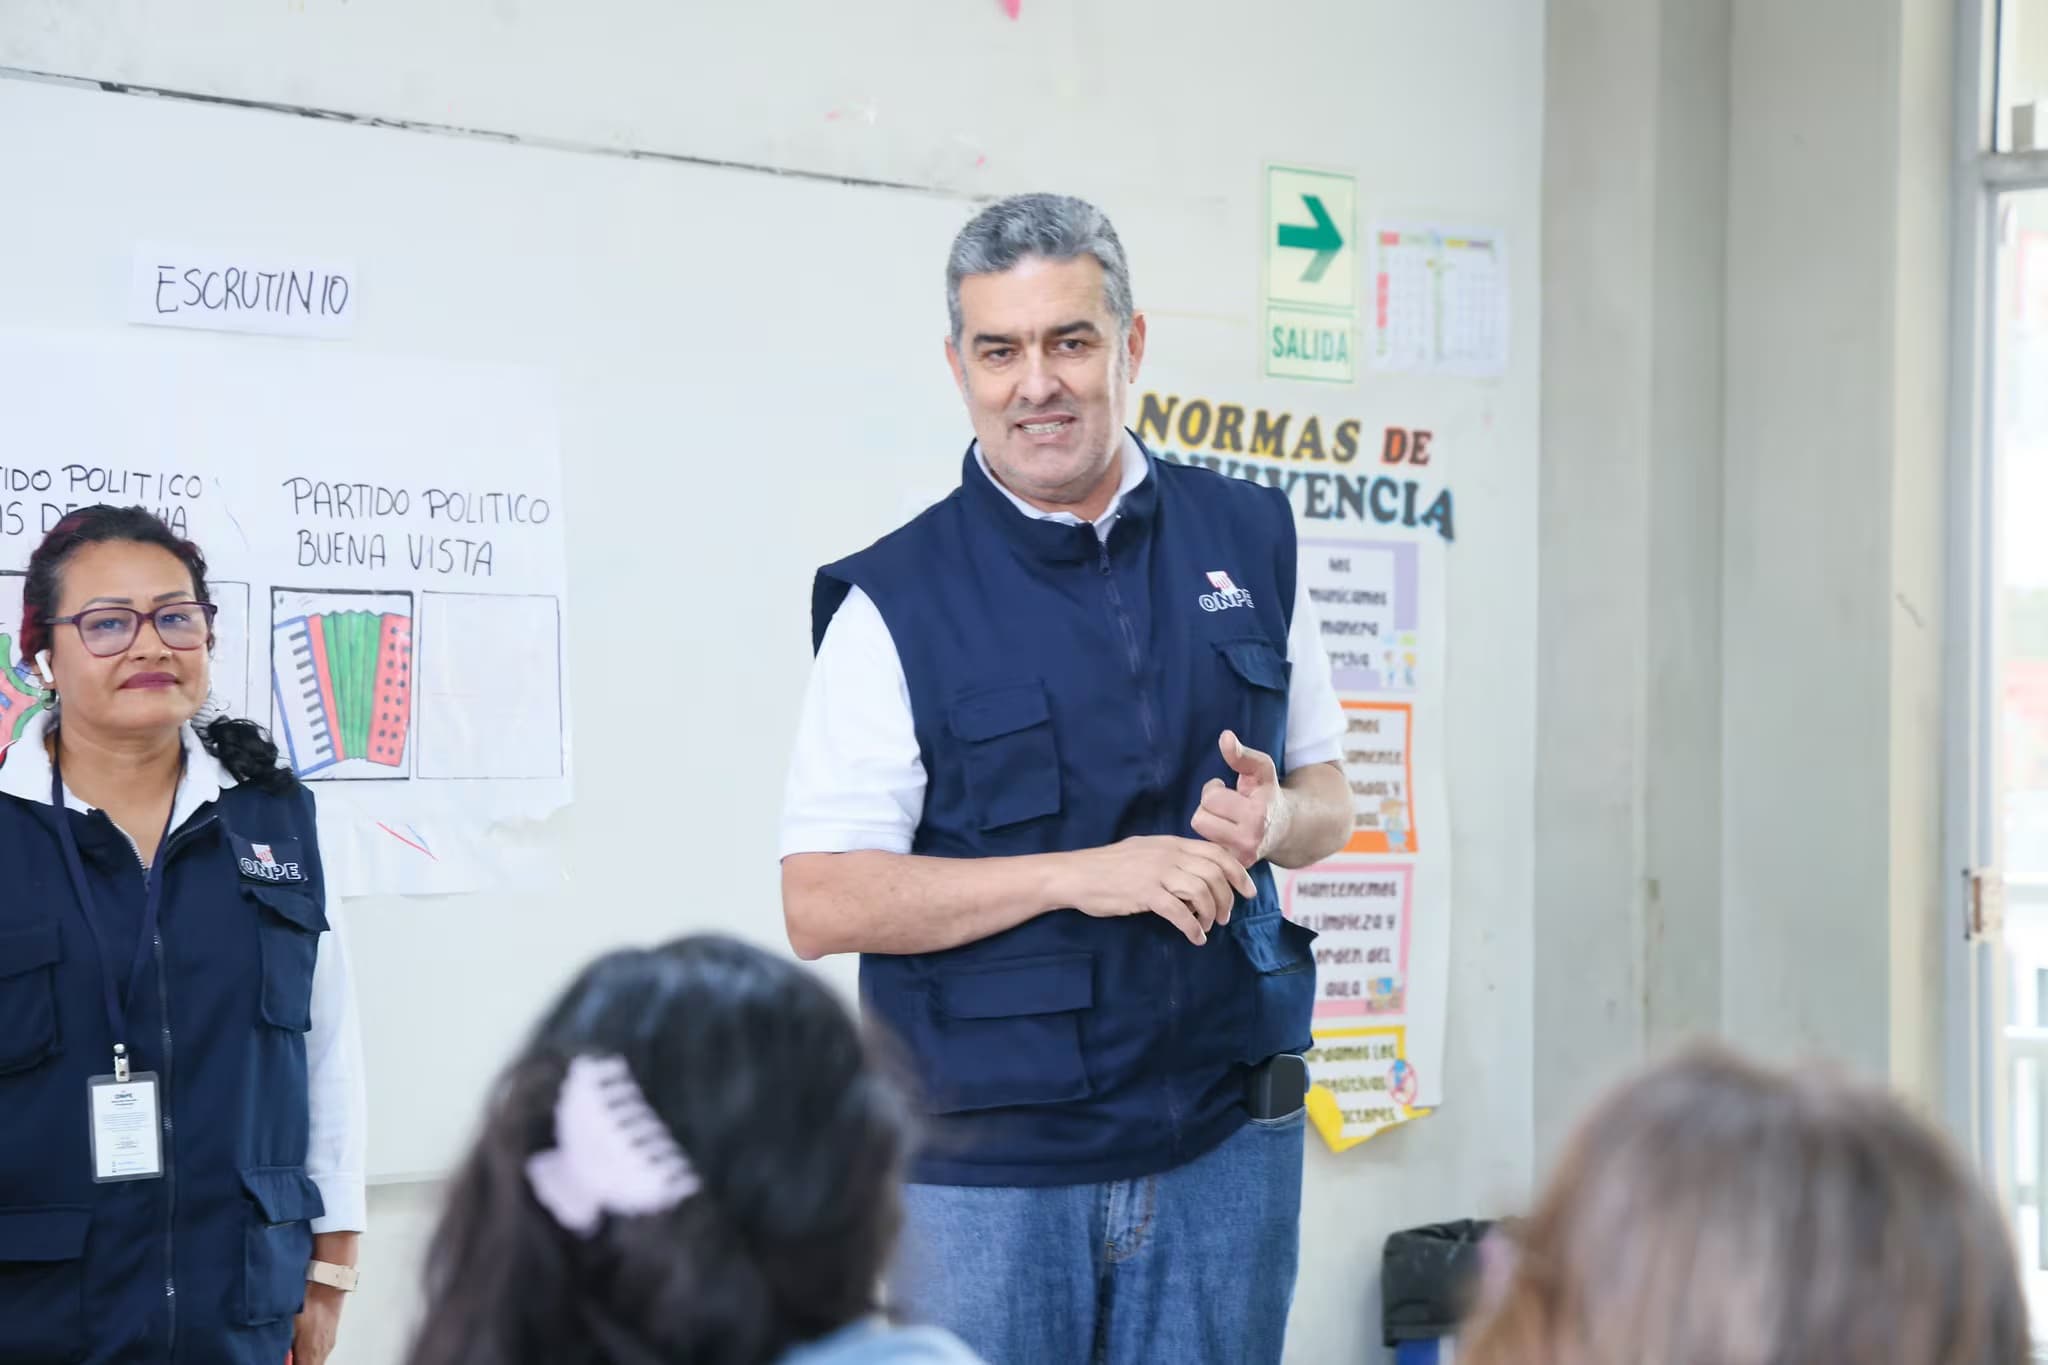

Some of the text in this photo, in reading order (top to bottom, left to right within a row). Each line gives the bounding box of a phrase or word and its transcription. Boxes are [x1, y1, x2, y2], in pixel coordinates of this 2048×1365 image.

[156, 265, 349, 315] ESCRUTINIO
[1272, 325, 1349, 365] SALIDA
[1136, 392, 1433, 466] NORMAS DE
[61, 464, 202, 501] POLITICO
[282, 476, 550, 525] PARTIDO POLITICO
[297, 529, 494, 577] BUENA VISTA
[240, 857, 302, 882] ONPE
